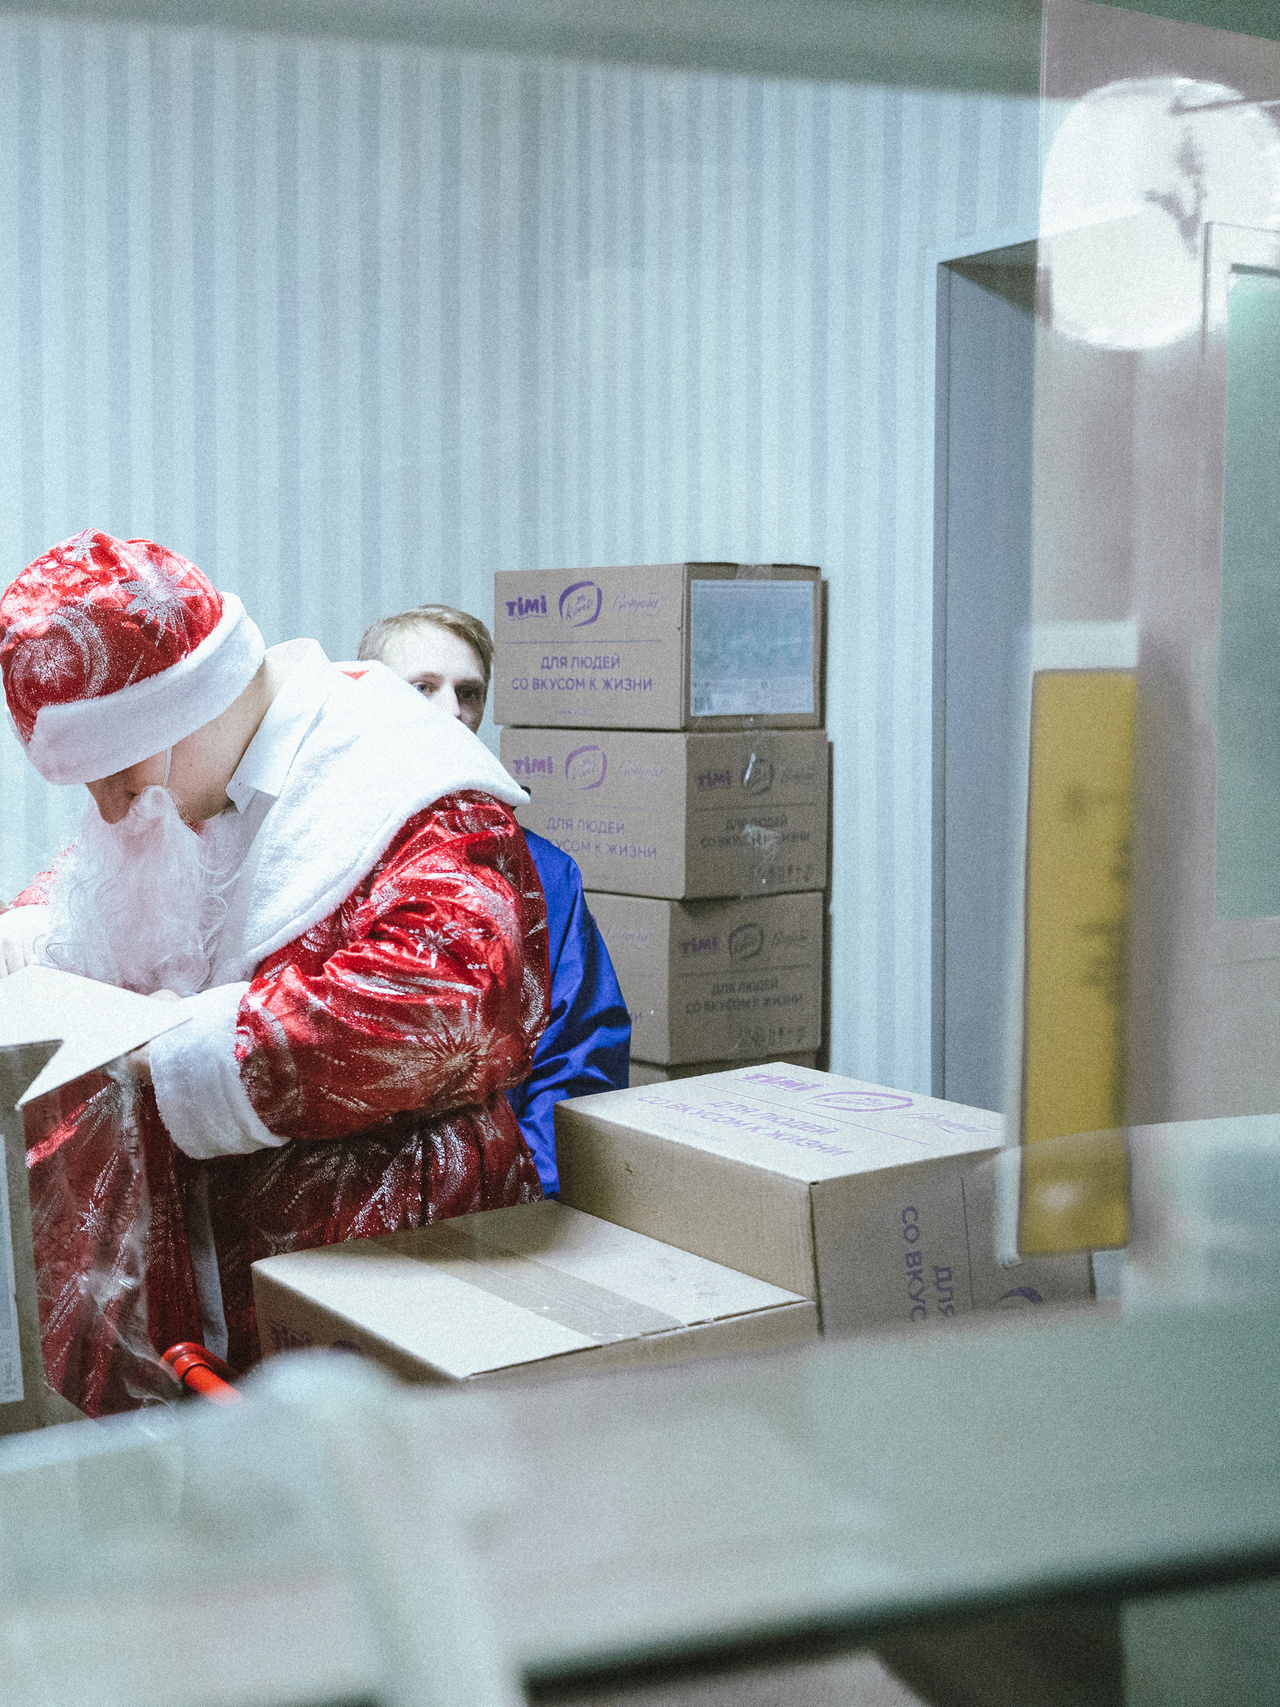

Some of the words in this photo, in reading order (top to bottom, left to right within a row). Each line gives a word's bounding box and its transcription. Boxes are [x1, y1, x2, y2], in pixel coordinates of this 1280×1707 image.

[540, 656, 568, 670] ДЛЯ
[570, 653, 621, 670] ЛЮДЕЙ
[511, 678, 528, 690] СО
[532, 678, 585, 691] ВКУСОМ
[589, 678, 597, 690] К
[602, 678, 653, 691] ЖИЗНИ
[547, 816, 574, 831] ДЛЯ
[577, 818, 625, 835] ЛЮДЕЙ
[551, 838, 590, 853] УСОМ
[594, 842, 602, 851] К
[608, 842, 657, 860] ЖИЗНИ
[637, 1096, 671, 1105] СО
[665, 1103, 751, 1128] ВКУСОМ
[761, 1130, 853, 1156] ЖИЗНИ
[704, 1100, 759, 1114] ДЛЯ
[759, 1111, 841, 1135] ЛЮДЕЙ
[902, 1206, 920, 1244] СО
[905, 1250, 927, 1322] ВКУС
[934, 1265, 955, 1317] ДЛЯ
